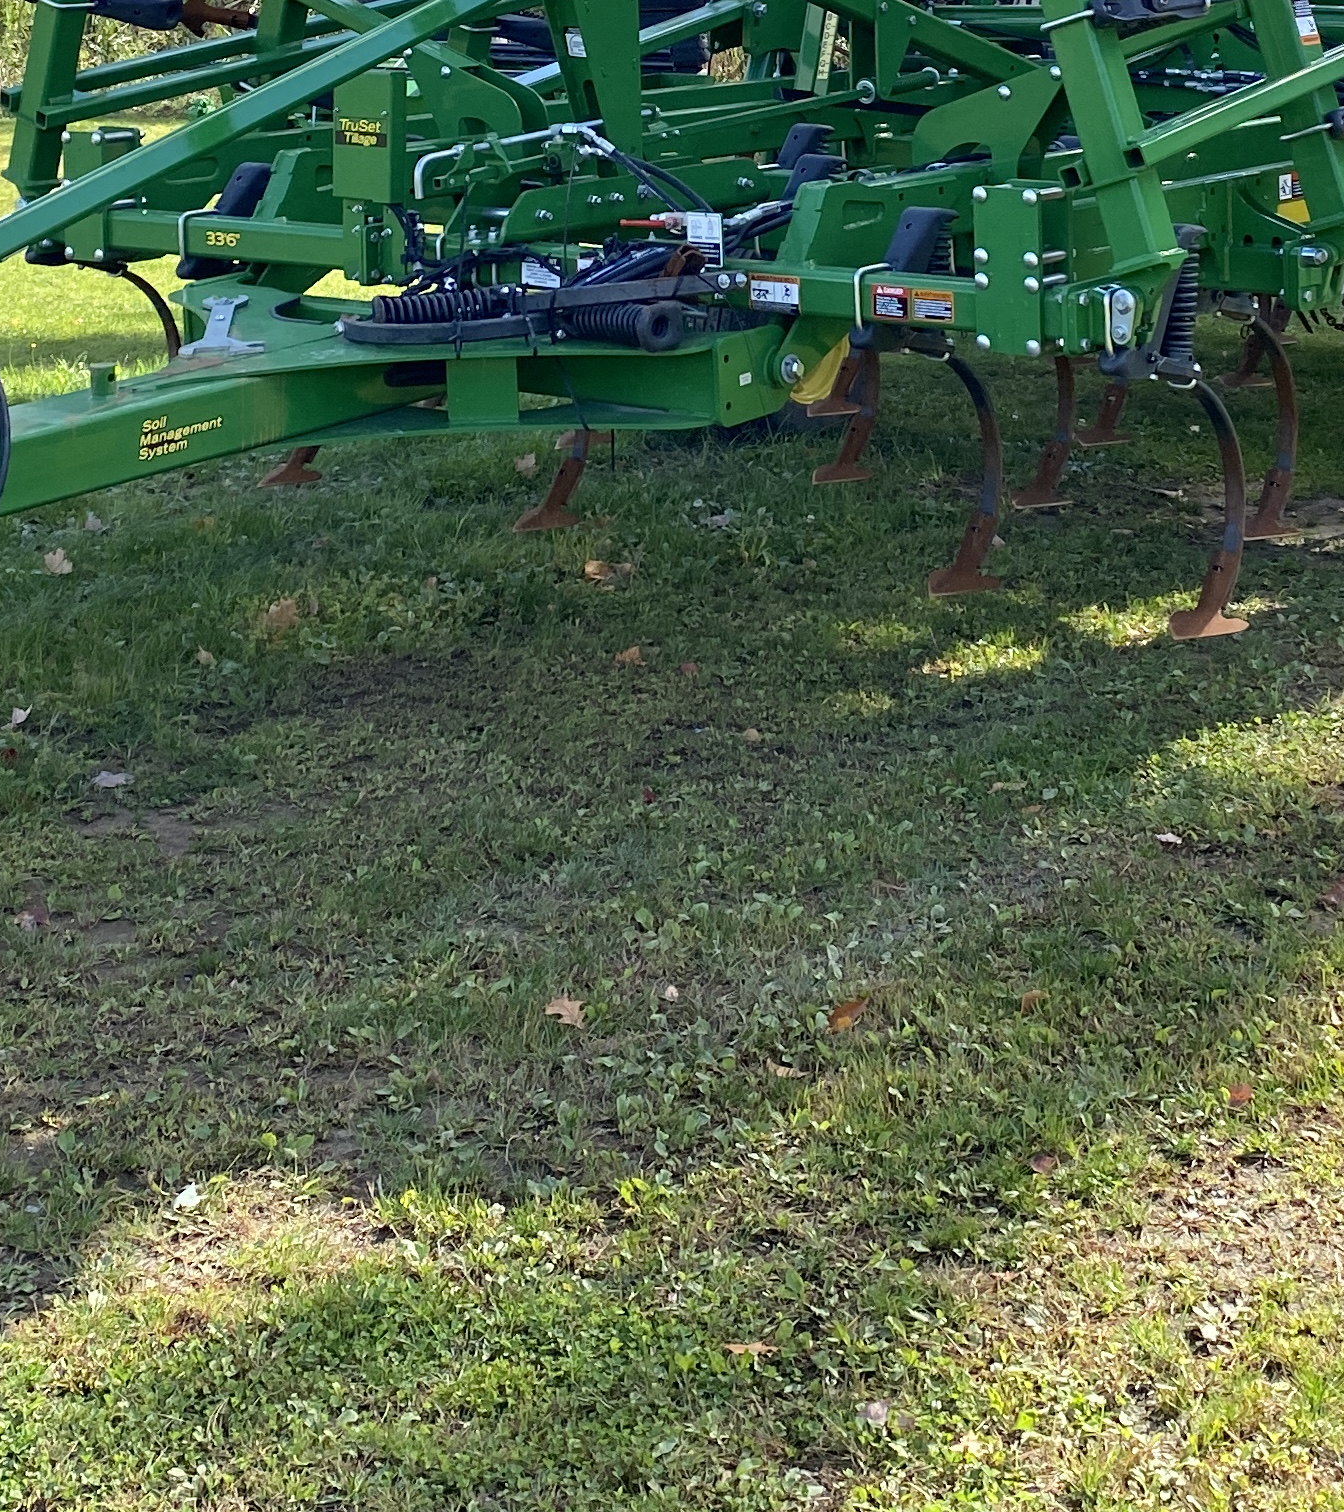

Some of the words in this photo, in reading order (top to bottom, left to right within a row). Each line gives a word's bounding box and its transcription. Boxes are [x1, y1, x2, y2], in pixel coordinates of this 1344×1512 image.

[338, 118, 382, 133] TruSet
[344, 131, 378, 147] Tillage
[139, 416, 223, 447] Management
[141, 415, 168, 433] Soil
[138, 439, 188, 461] System
